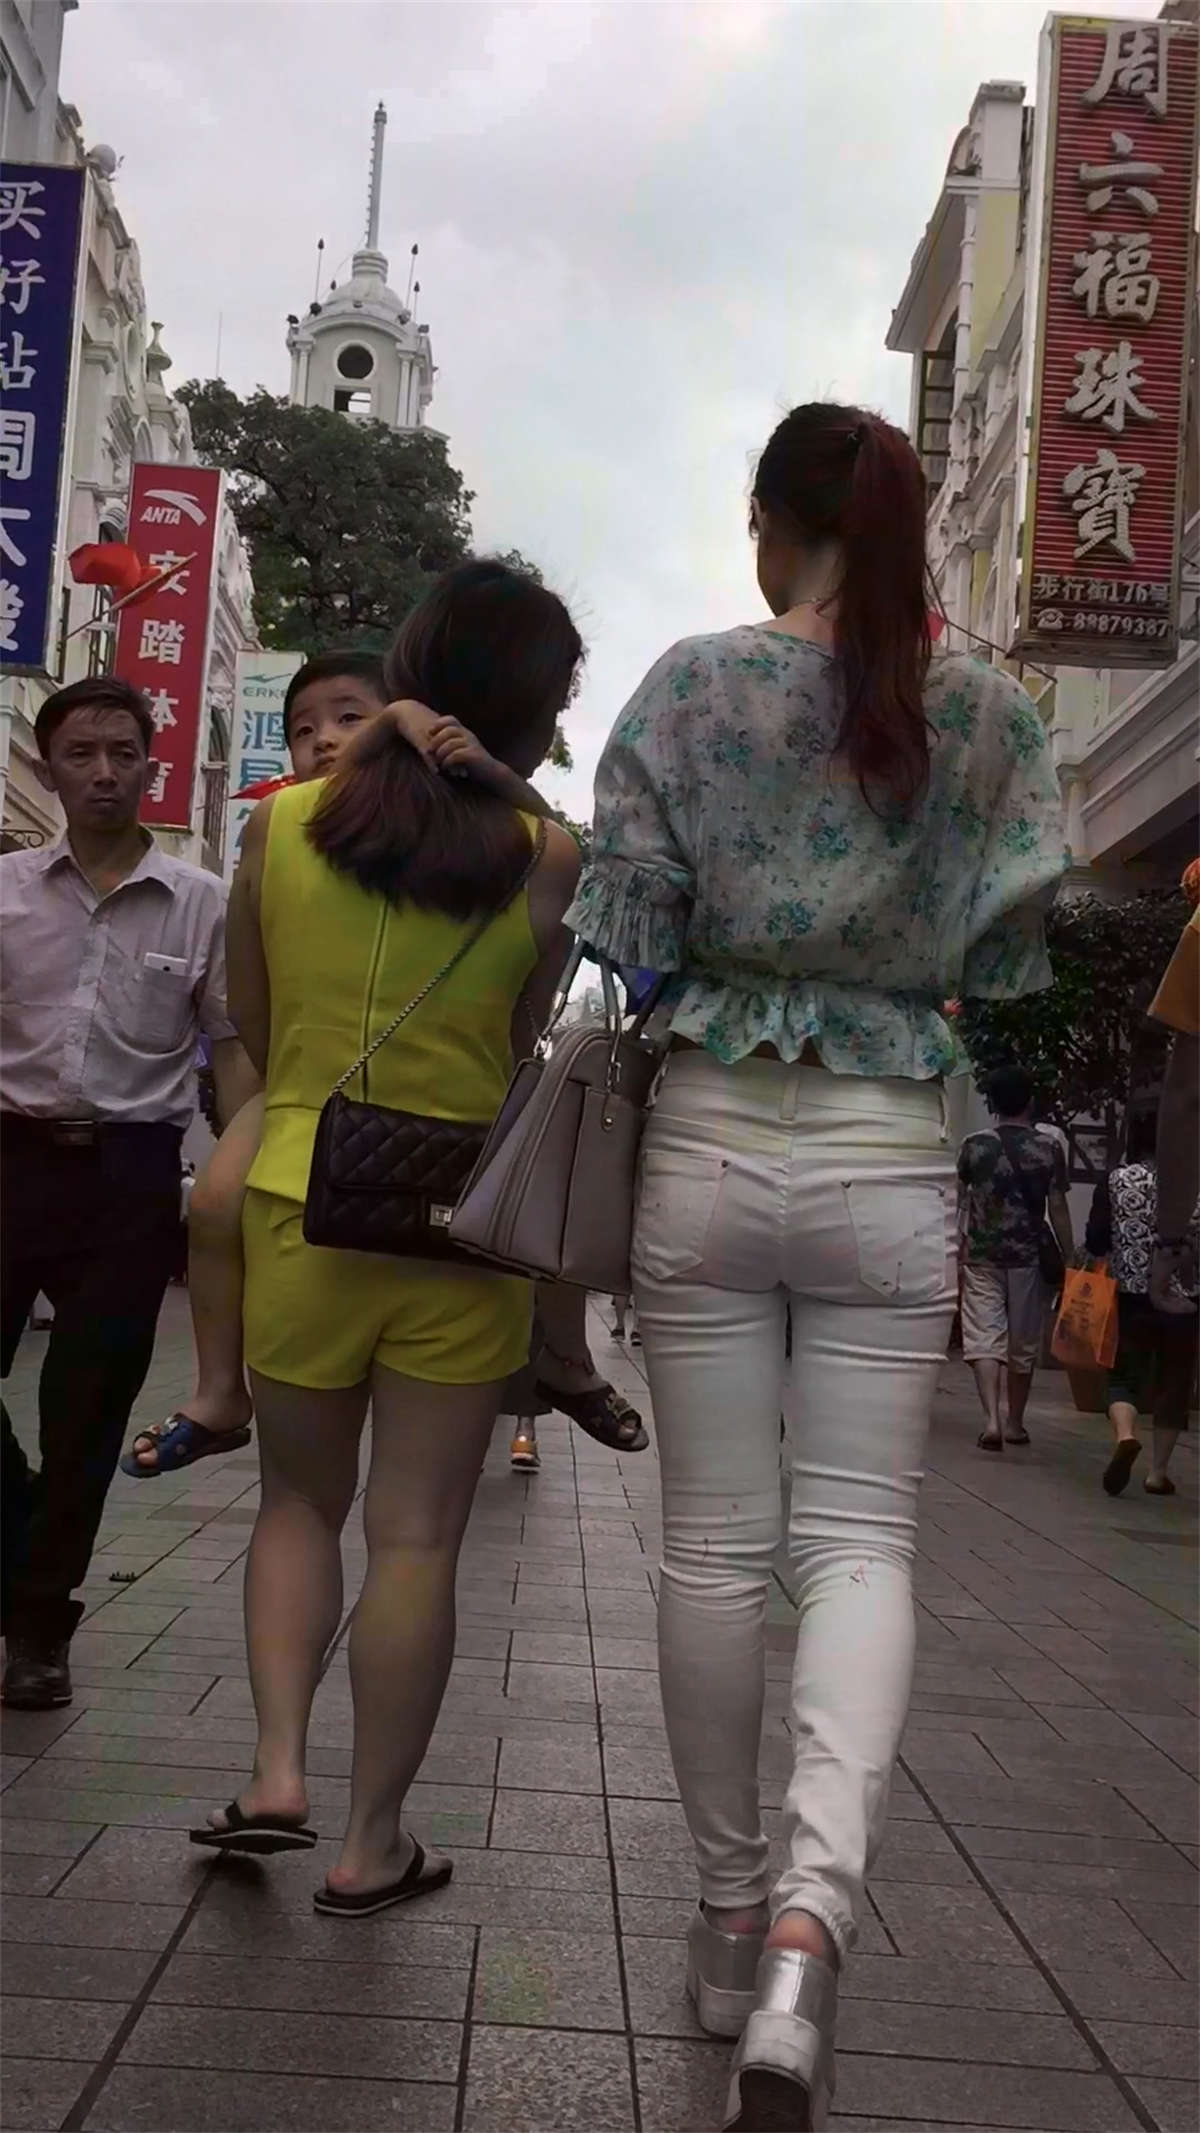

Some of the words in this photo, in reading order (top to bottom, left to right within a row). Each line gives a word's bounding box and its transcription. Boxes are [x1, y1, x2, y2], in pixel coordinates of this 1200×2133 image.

[1062, 22, 1170, 563] 周六福珠寶
[140, 506, 182, 525] ANTA
